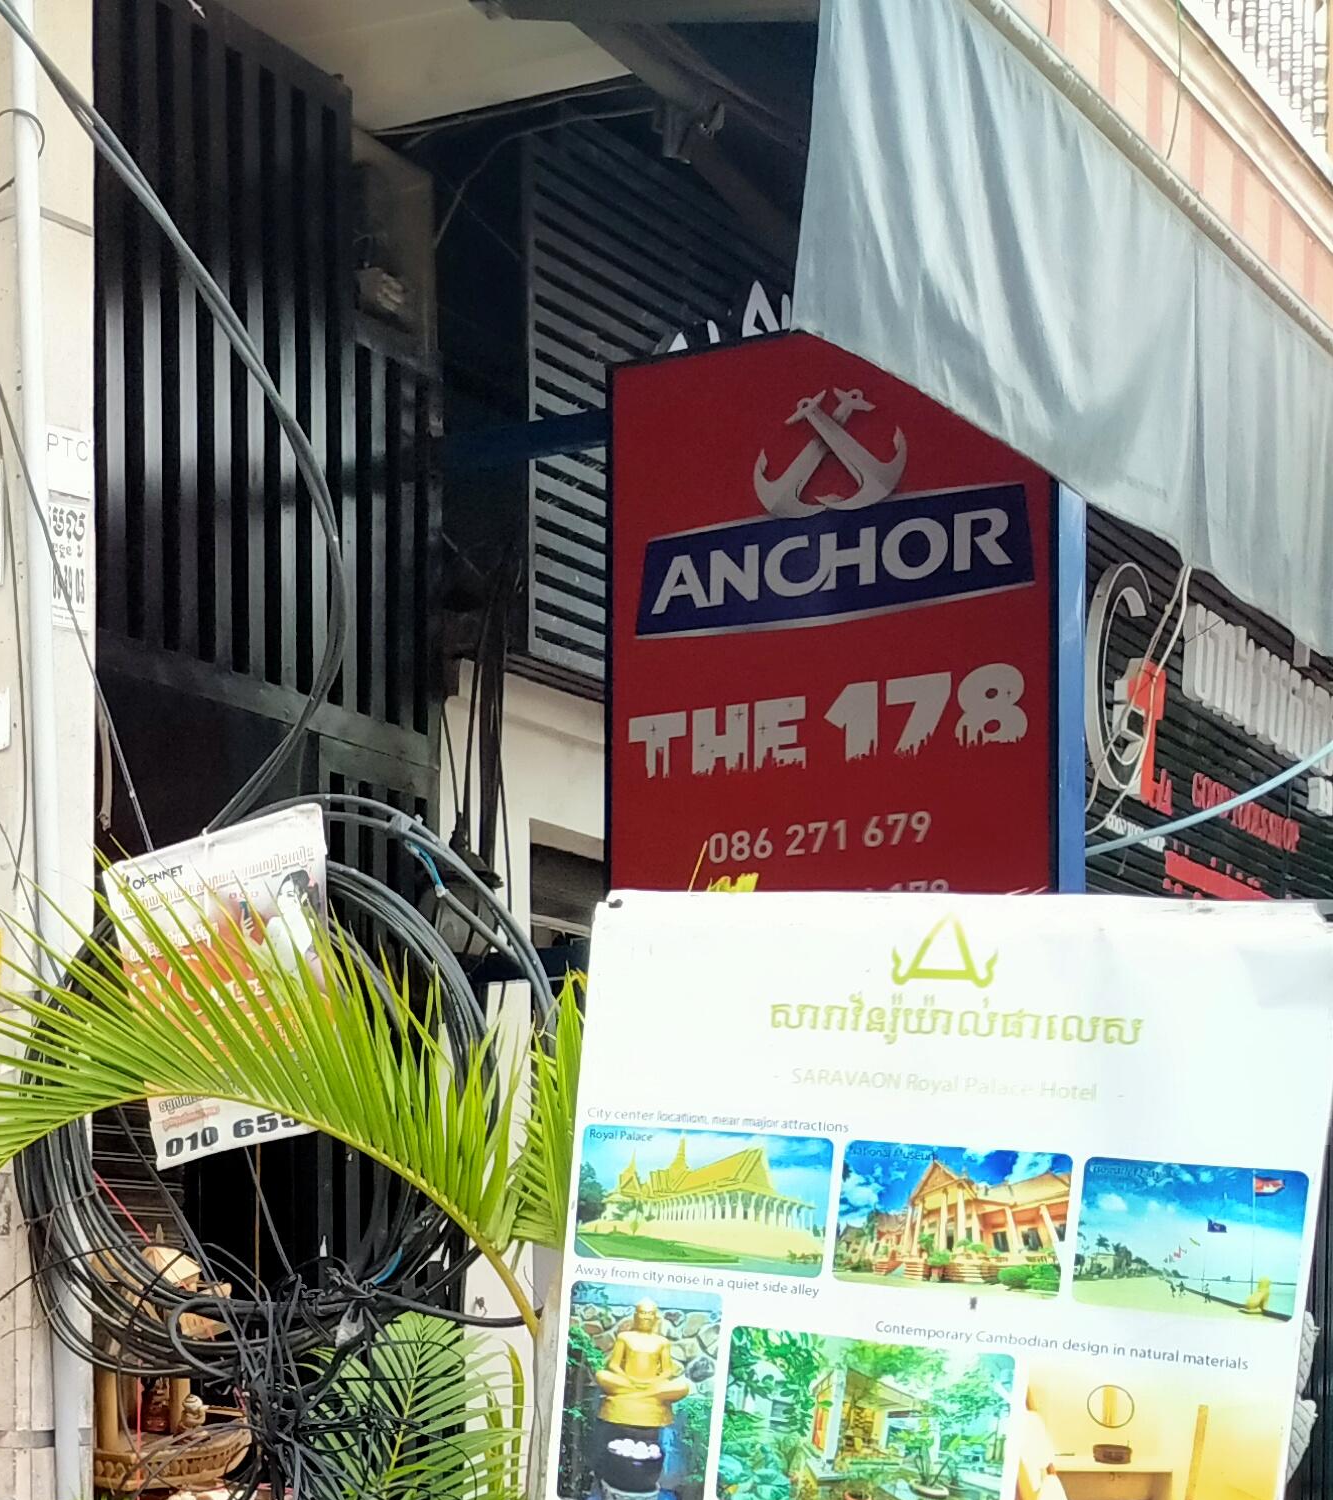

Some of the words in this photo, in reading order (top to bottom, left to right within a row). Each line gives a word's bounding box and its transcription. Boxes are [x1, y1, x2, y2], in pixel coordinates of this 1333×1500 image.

[651, 508, 1013, 615] ANCHOR
[629, 696, 807, 779] THE
[824, 662, 1029, 763] 178
[708, 827, 773, 864] 086
[785, 819, 848, 858] 271
[863, 810, 932, 849] 679
[792, 1067, 902, 1091] SARAVAON
[906, 1075, 958, 1096] Royal
[1041, 1082, 1099, 1103] Hotel
[587, 1107, 611, 1121] City
[614, 1111, 654, 1121] center
[780, 1119, 849, 1133] attractions
[588, 1128, 617, 1142] Royal
[619, 1130, 654, 1142] Palace
[165, 1127, 220, 1158] 010
[574, 1263, 608, 1279] Away
[610, 1266, 640, 1279] from
[642, 1270, 664, 1284] city
[667, 1273, 700, 1285] noise
[702, 1275, 714, 1286] in
[716, 1278, 724, 1287] a
[726, 1278, 759, 1291] quiet
[762, 1281, 788, 1294] side
[790, 1283, 819, 1299] alley
[875, 1320, 972, 1342] Contemporary
[975, 1330, 1058, 1348] Cambodian
[1062, 1338, 1109, 1356] design
[1112, 1343, 1125, 1356] in
[1129, 1348, 1179, 1362] natural
[1182, 1354, 1248, 1370] materials
